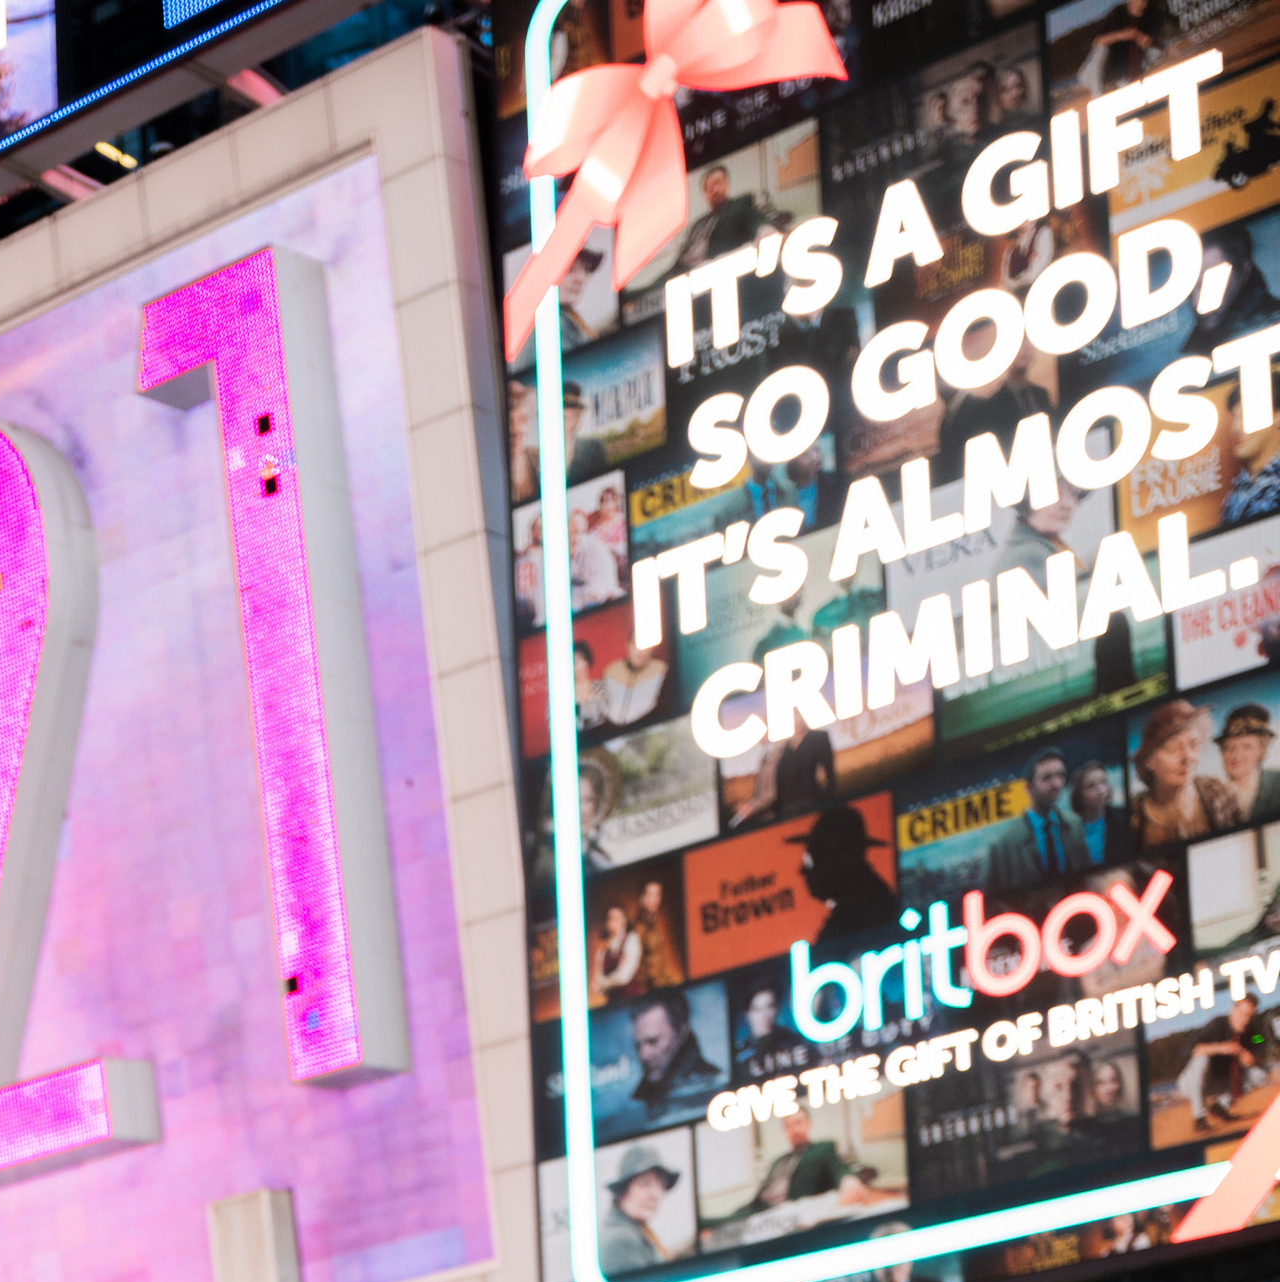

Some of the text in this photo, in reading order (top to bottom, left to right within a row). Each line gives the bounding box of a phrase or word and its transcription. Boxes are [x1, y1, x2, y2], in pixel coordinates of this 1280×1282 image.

[665, 216, 843, 368] IT'S
[863, 179, 944, 288] A
[961, 48, 1223, 236] GIFT
[687, 365, 830, 490] SO
[851, 219, 1233, 422] GOOD,
[632, 325, 1280, 650] IT'S ALMOST
[1130, 459, 1182, 494] FRY
[1131, 471, 1223, 518] LAURIE
[691, 511, 1259, 758] CRIMINAL.
[908, 790, 1012, 844] CRIME
[700, 887, 796, 936] Brown
[719, 870, 777, 898] Father
[789, 869, 1177, 1044] britbox
[707, 949, 1280, 1132] GIVE THE GIFT OF BRITISH TV
[748, 1043, 810, 1078] LINE
